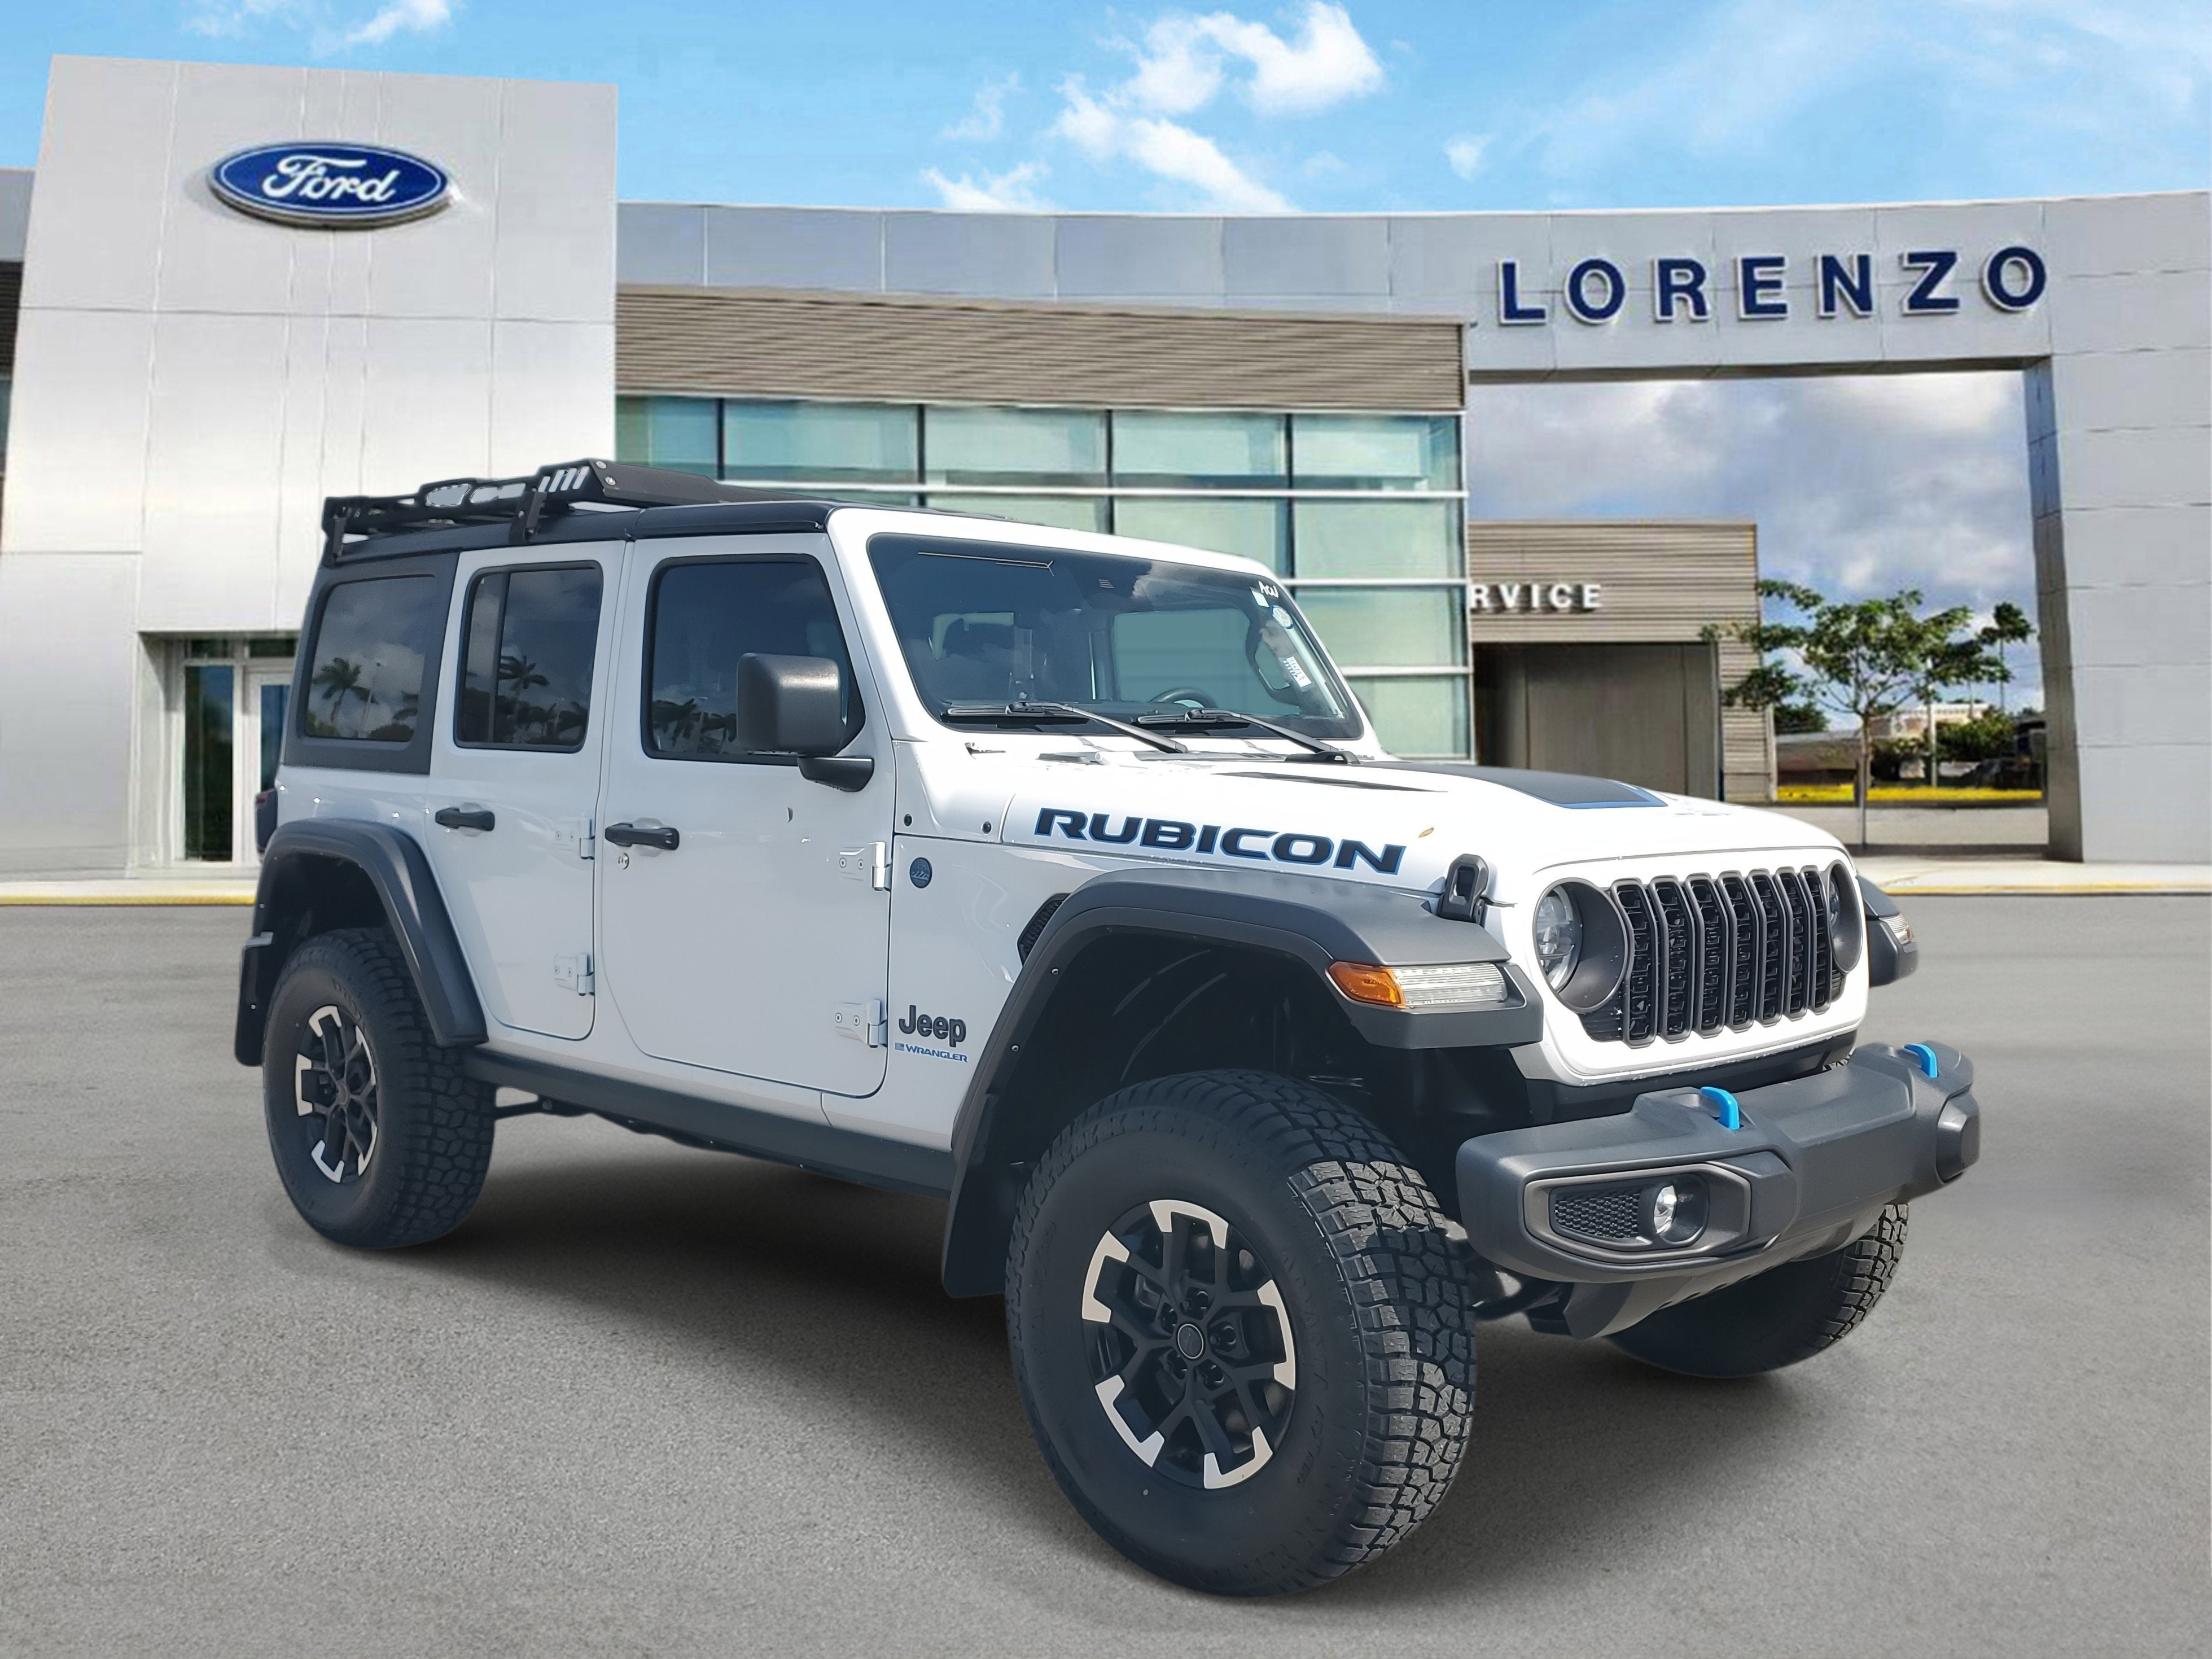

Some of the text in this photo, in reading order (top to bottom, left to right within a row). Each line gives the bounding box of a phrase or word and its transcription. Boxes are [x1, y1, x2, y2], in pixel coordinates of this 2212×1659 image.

[262, 155, 400, 201] Ford
[1497, 246, 2047, 324] LORENZO
[1034, 807, 1406, 875] RUBICON
[899, 1005, 966, 1047] Jeep
[906, 1044, 967, 1062] WRANGLER
